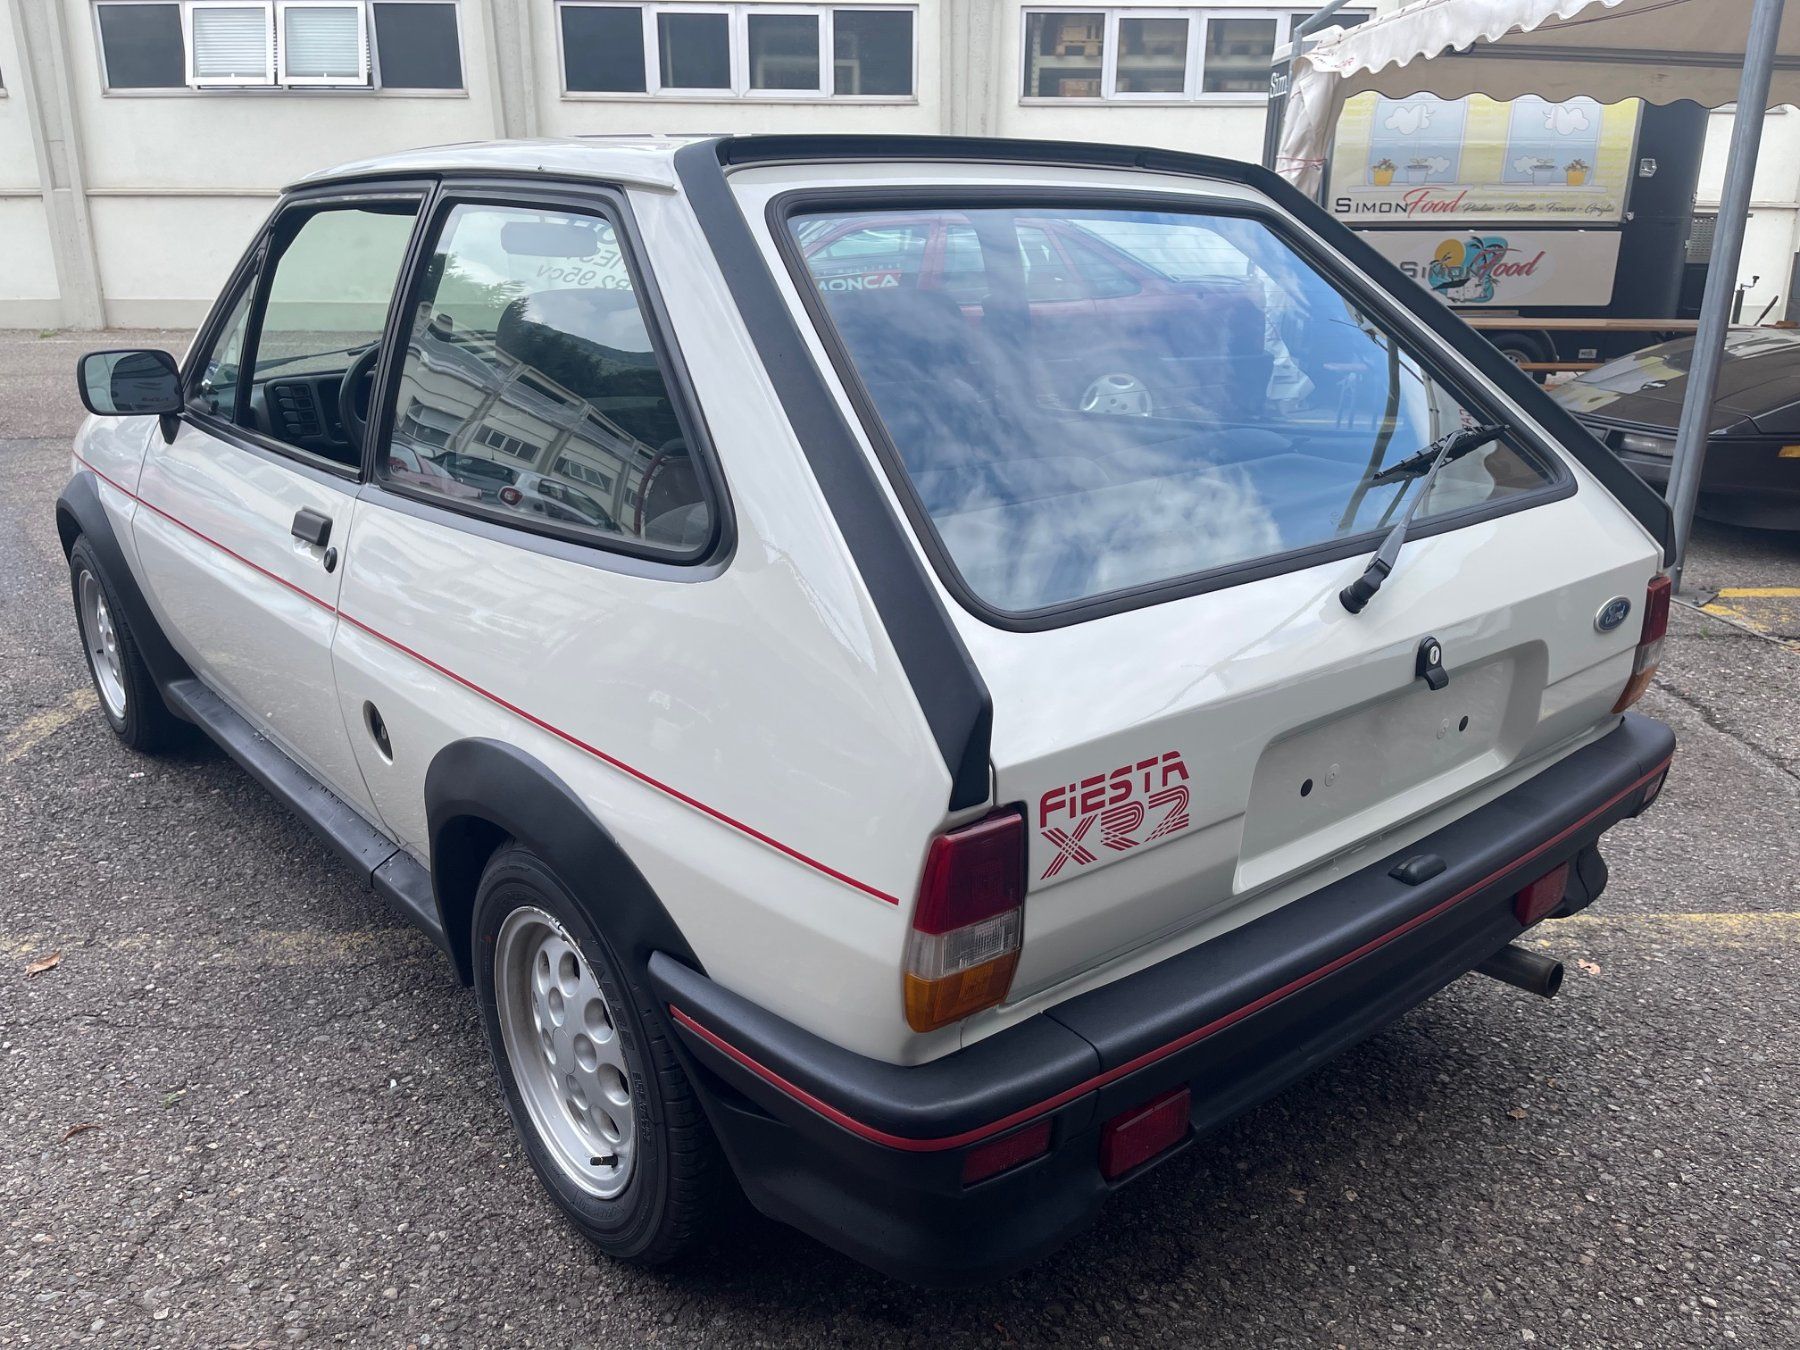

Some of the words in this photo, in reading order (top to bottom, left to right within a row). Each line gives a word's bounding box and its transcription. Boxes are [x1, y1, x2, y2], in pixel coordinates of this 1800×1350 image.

[1334, 197, 1409, 214] SIMON
[1403, 187, 1467, 218] Food
[1470, 248, 1546, 280] Food
[1039, 750, 1190, 829] FIESTA
[1039, 784, 1190, 881] XR2
